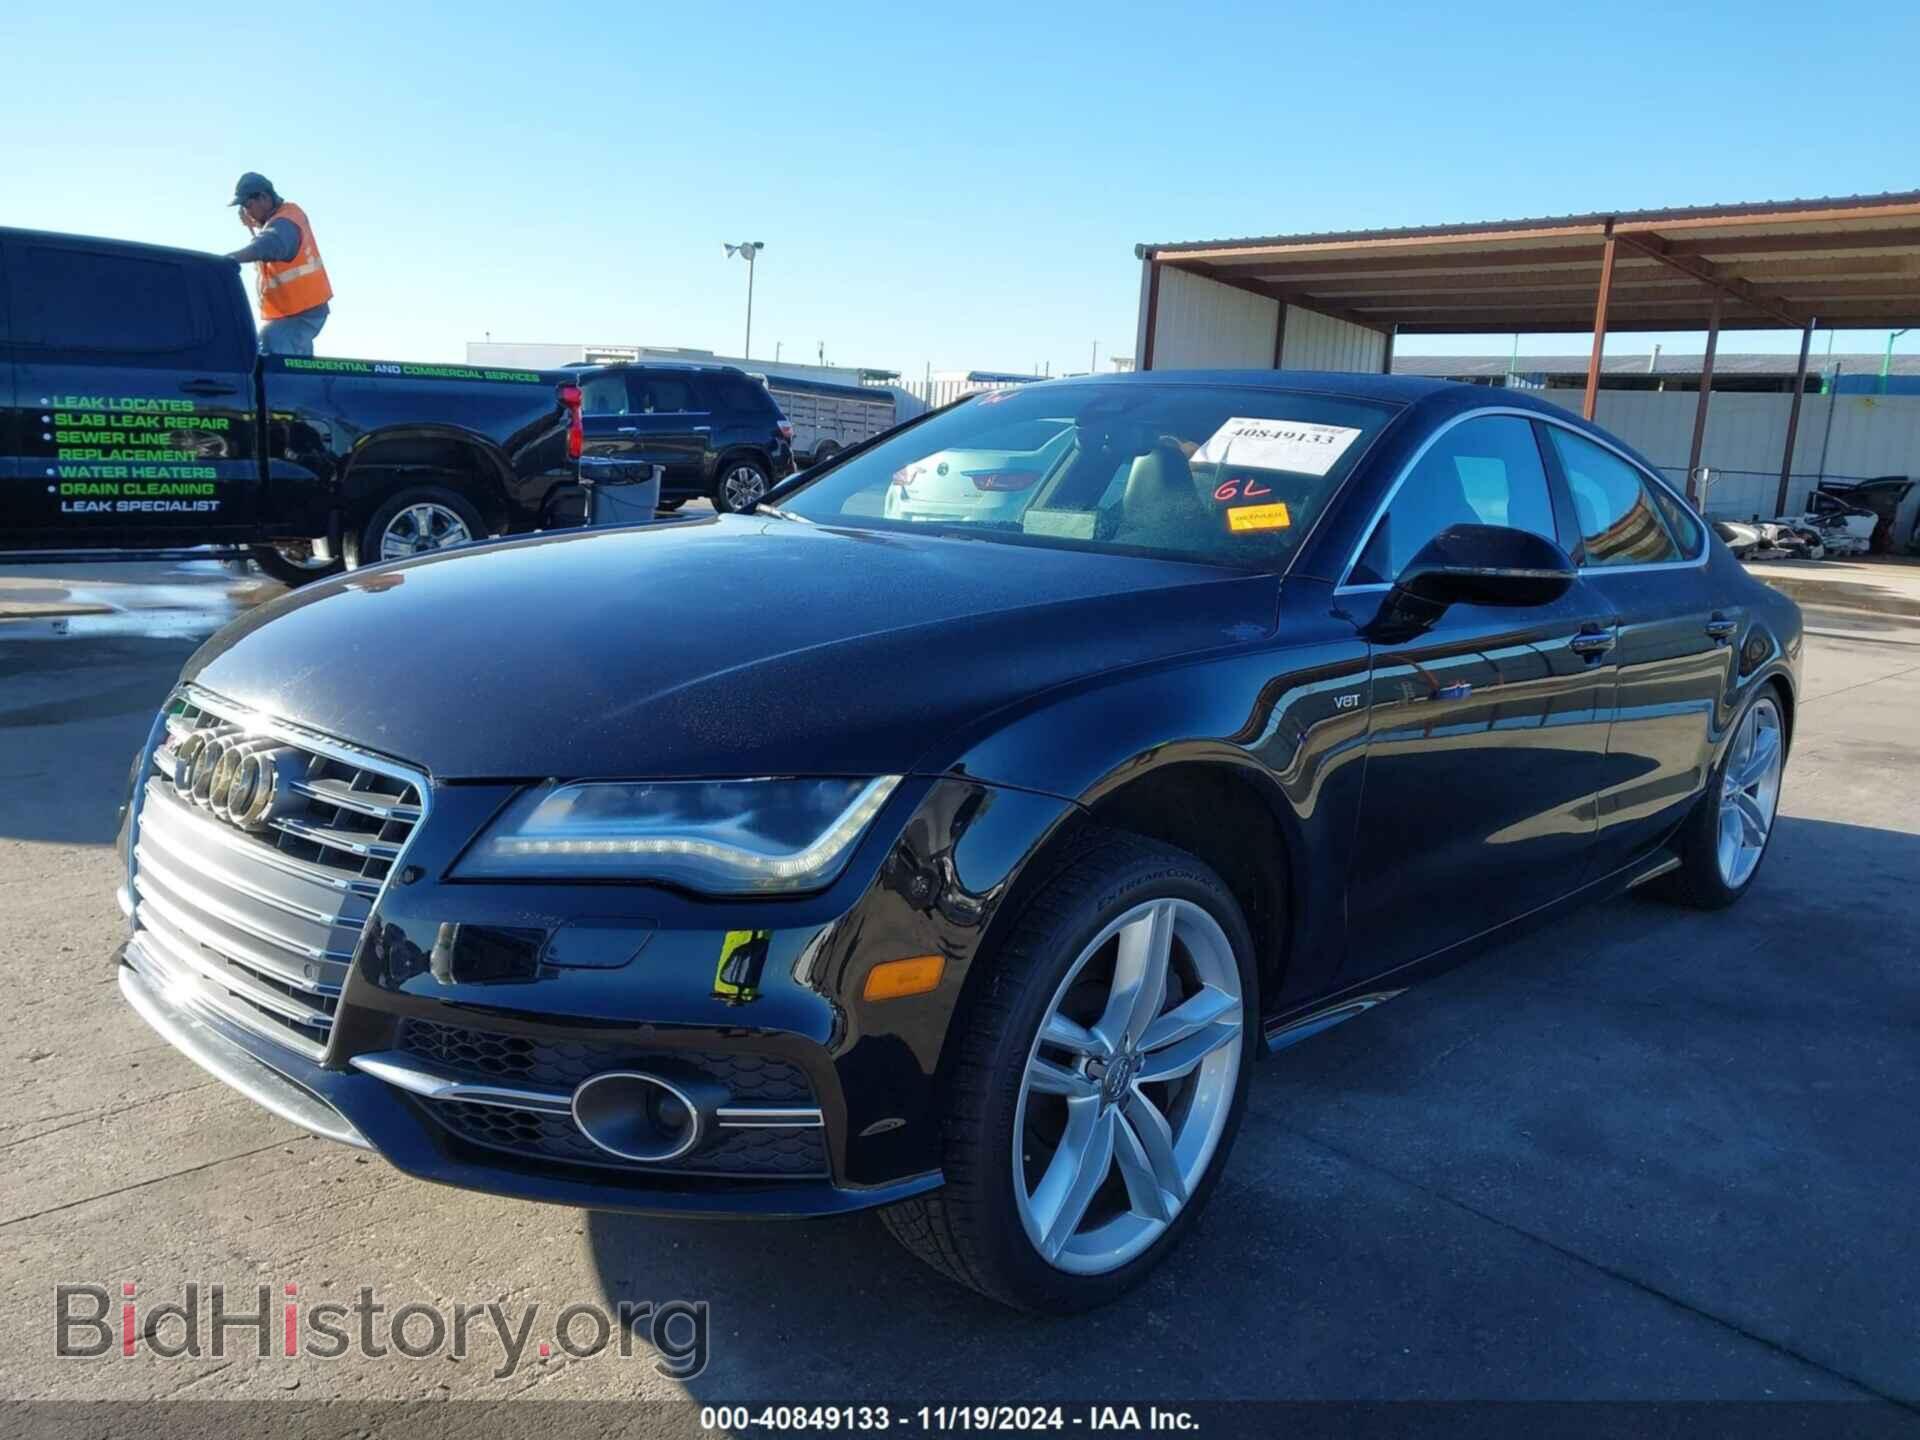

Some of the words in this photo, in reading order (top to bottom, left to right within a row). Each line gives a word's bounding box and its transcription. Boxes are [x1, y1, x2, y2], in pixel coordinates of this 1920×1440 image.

[284, 357, 372, 373] RESIDENTIAL
[374, 364, 401, 375] AND
[403, 365, 482, 379] COMMERCIAL
[484, 370, 540, 383] SERVICES
[53, 396, 104, 409] LEAK
[109, 399, 194, 412] LOCATES
[54, 413, 106, 426] SLAB
[110, 415, 160, 428] LEAK
[163, 417, 229, 430] REPAIR
[55, 431, 125, 444] SEWER
[129, 433, 171, 445] LINE
[1231, 428, 1334, 444] 40849133
[58, 448, 198, 462] REPLACEMENT
[58, 466, 128, 479] WATER
[132, 466, 217, 479] HEATERS
[60, 483, 119, 496] DRAIN
[123, 483, 214, 496] CLEANING
[61, 501, 112, 512] LEAK
[116, 500, 220, 512] SPECIALIST
[1333, 694, 1360, 709] V8T
